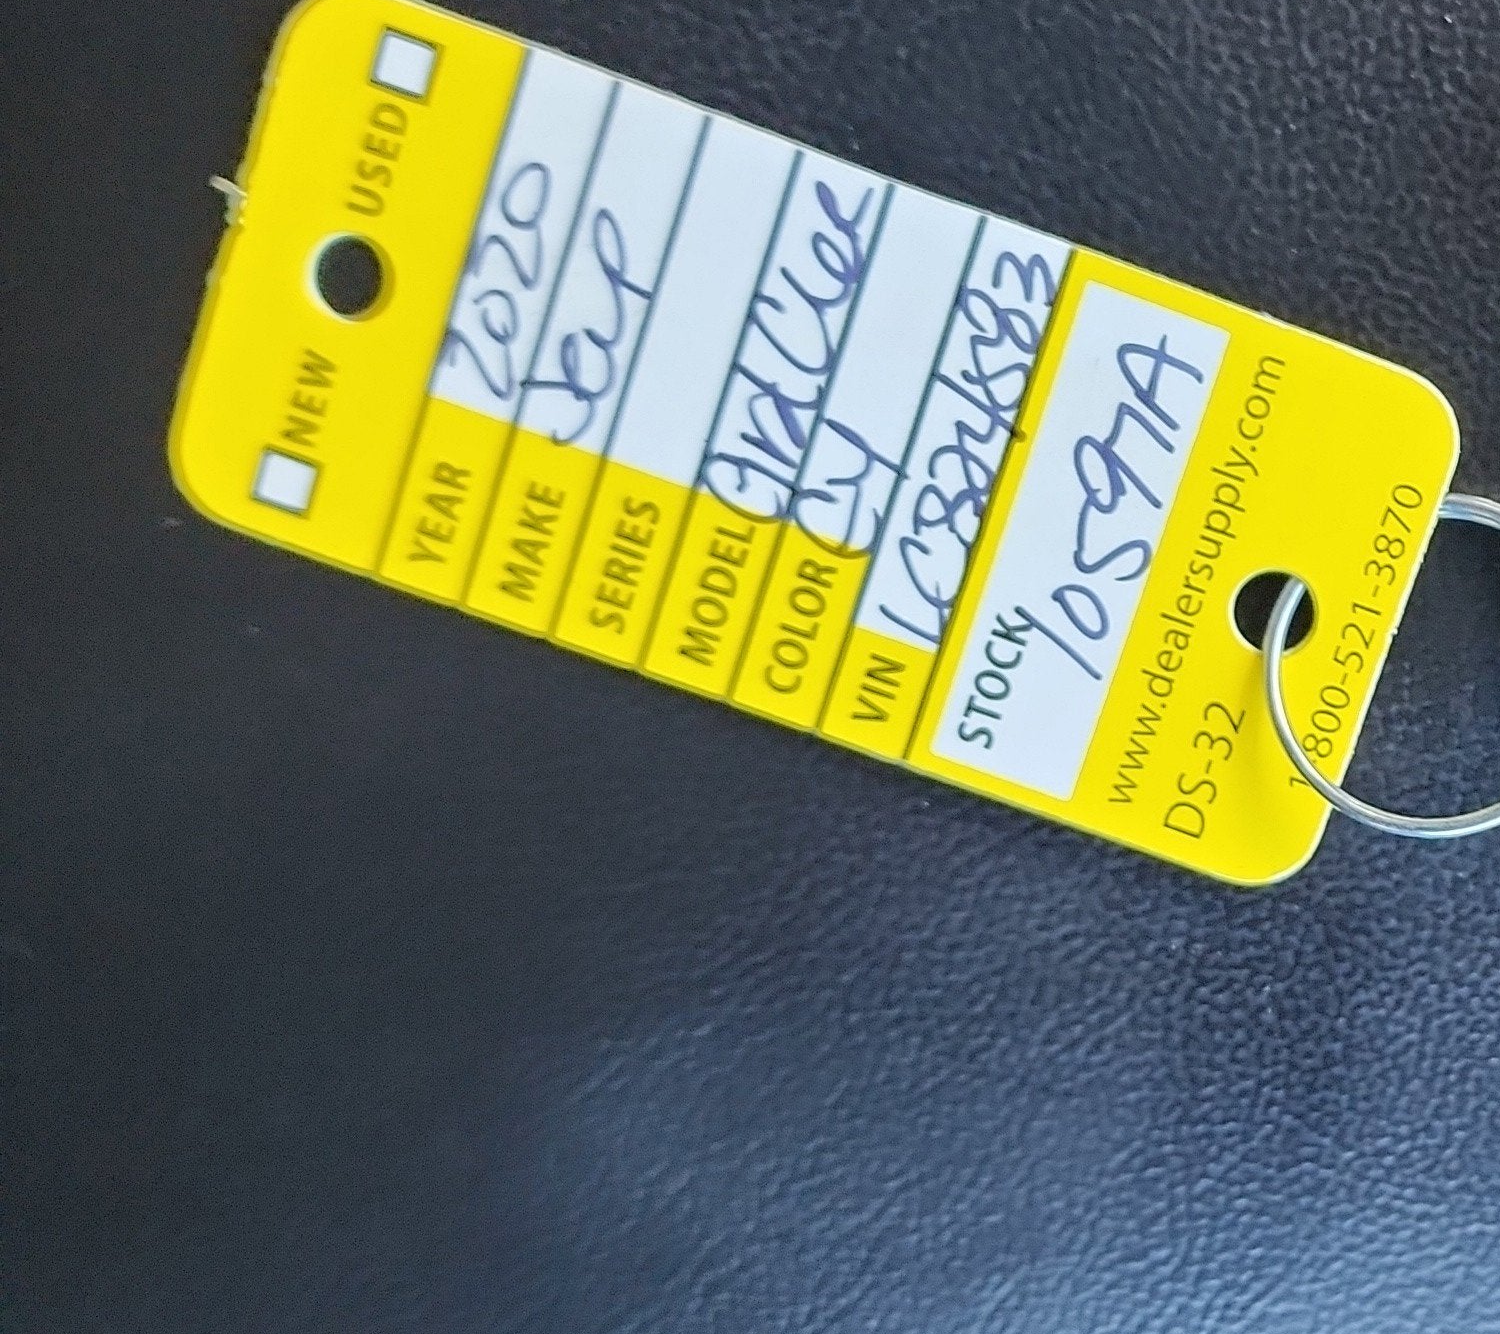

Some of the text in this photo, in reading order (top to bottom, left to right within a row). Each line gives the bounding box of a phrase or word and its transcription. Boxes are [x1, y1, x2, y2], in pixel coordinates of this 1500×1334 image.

[346, 101, 408, 217] USED
[448, 160, 551, 401] 2020
[280, 349, 338, 449] NEW
[408, 459, 472, 567] YEAR
[500, 481, 566, 603] MAKE
[589, 495, 662, 635] SERIES
[1020, 333, 1206, 681] 10597A
[678, 525, 756, 666] MODEL
[764, 558, 838, 694] COLOR
[1108, 354, 1287, 805] www.dealersupply.com
[1288, 483, 1424, 790] 1800-521-3870
[851, 652, 906, 722] VIN
[956, 613, 1034, 750] STOCK
[1164, 699, 1246, 839] DS-32
